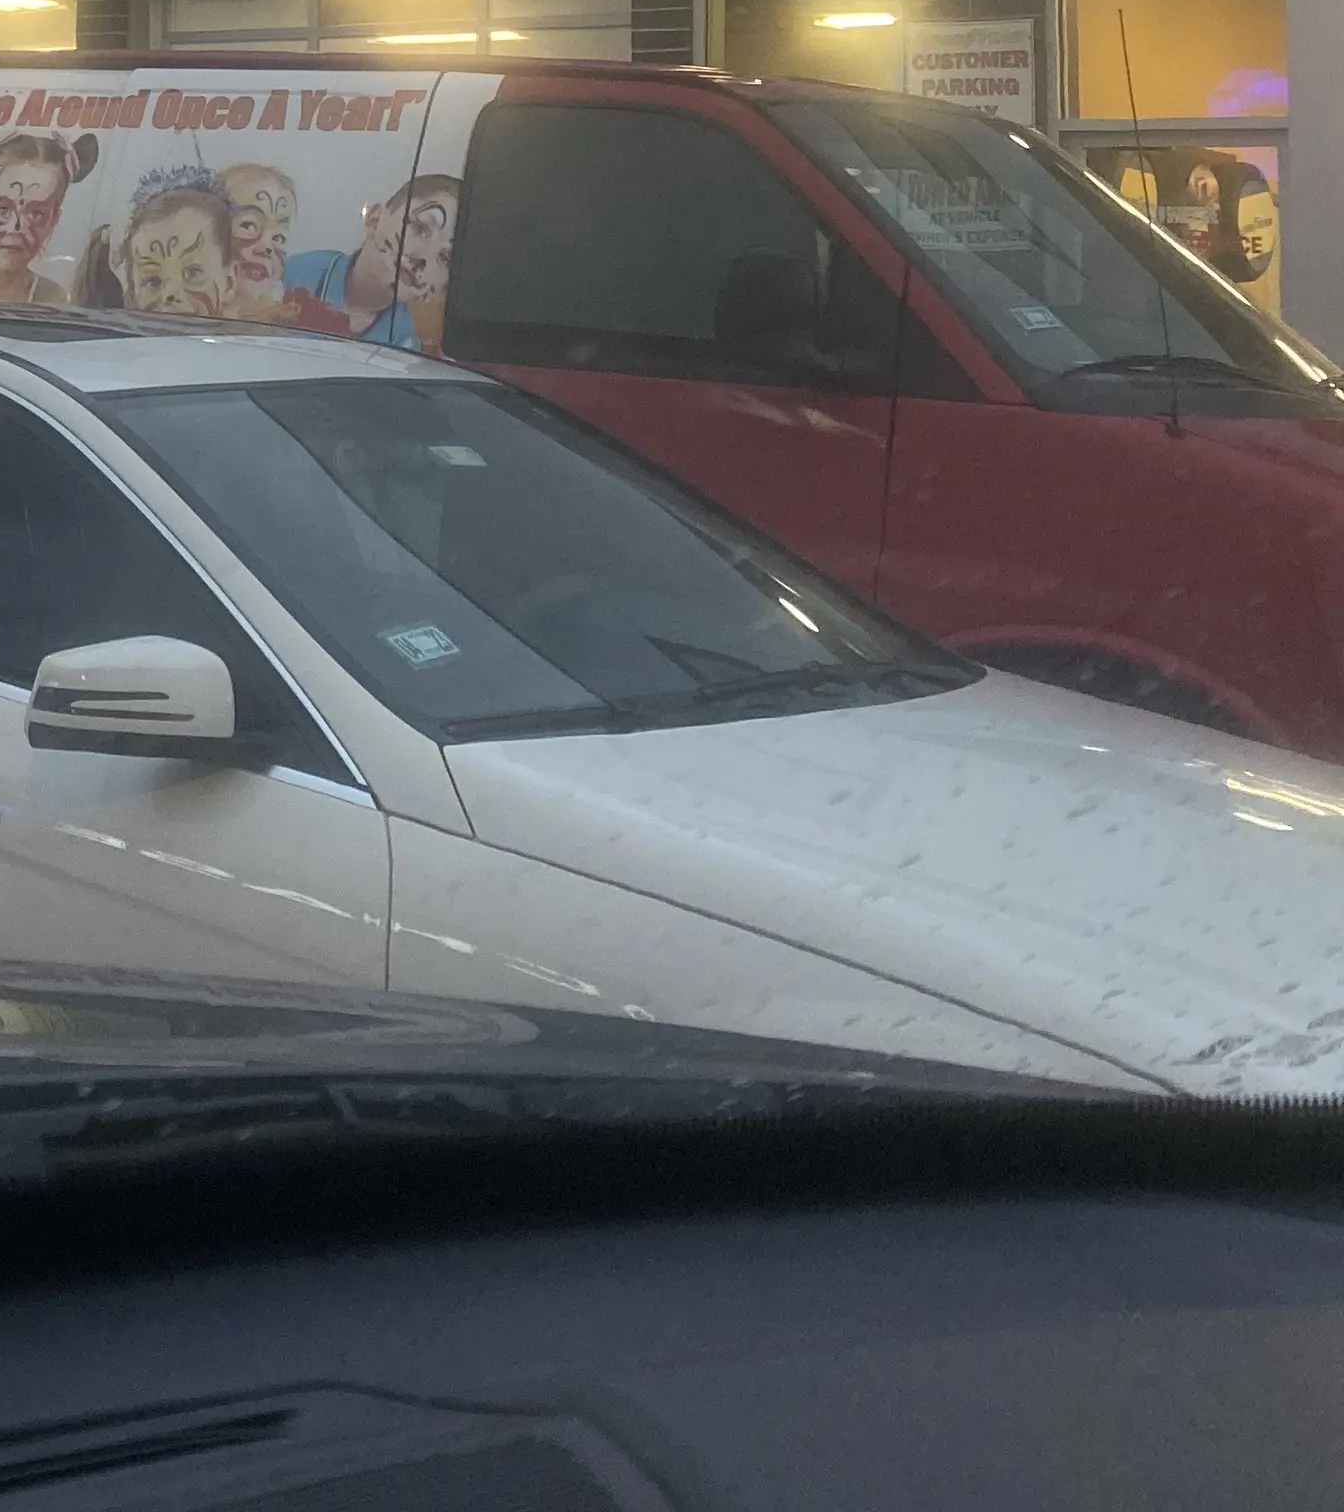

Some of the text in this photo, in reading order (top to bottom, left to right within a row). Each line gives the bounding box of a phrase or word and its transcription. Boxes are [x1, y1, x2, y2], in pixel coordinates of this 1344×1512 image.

[912, 50, 1030, 70] CUSTOMER
[922, 76, 1020, 97] PARKING
[15, 88, 151, 129] Around
[151, 88, 255, 134] Once
[257, 89, 291, 131] A
